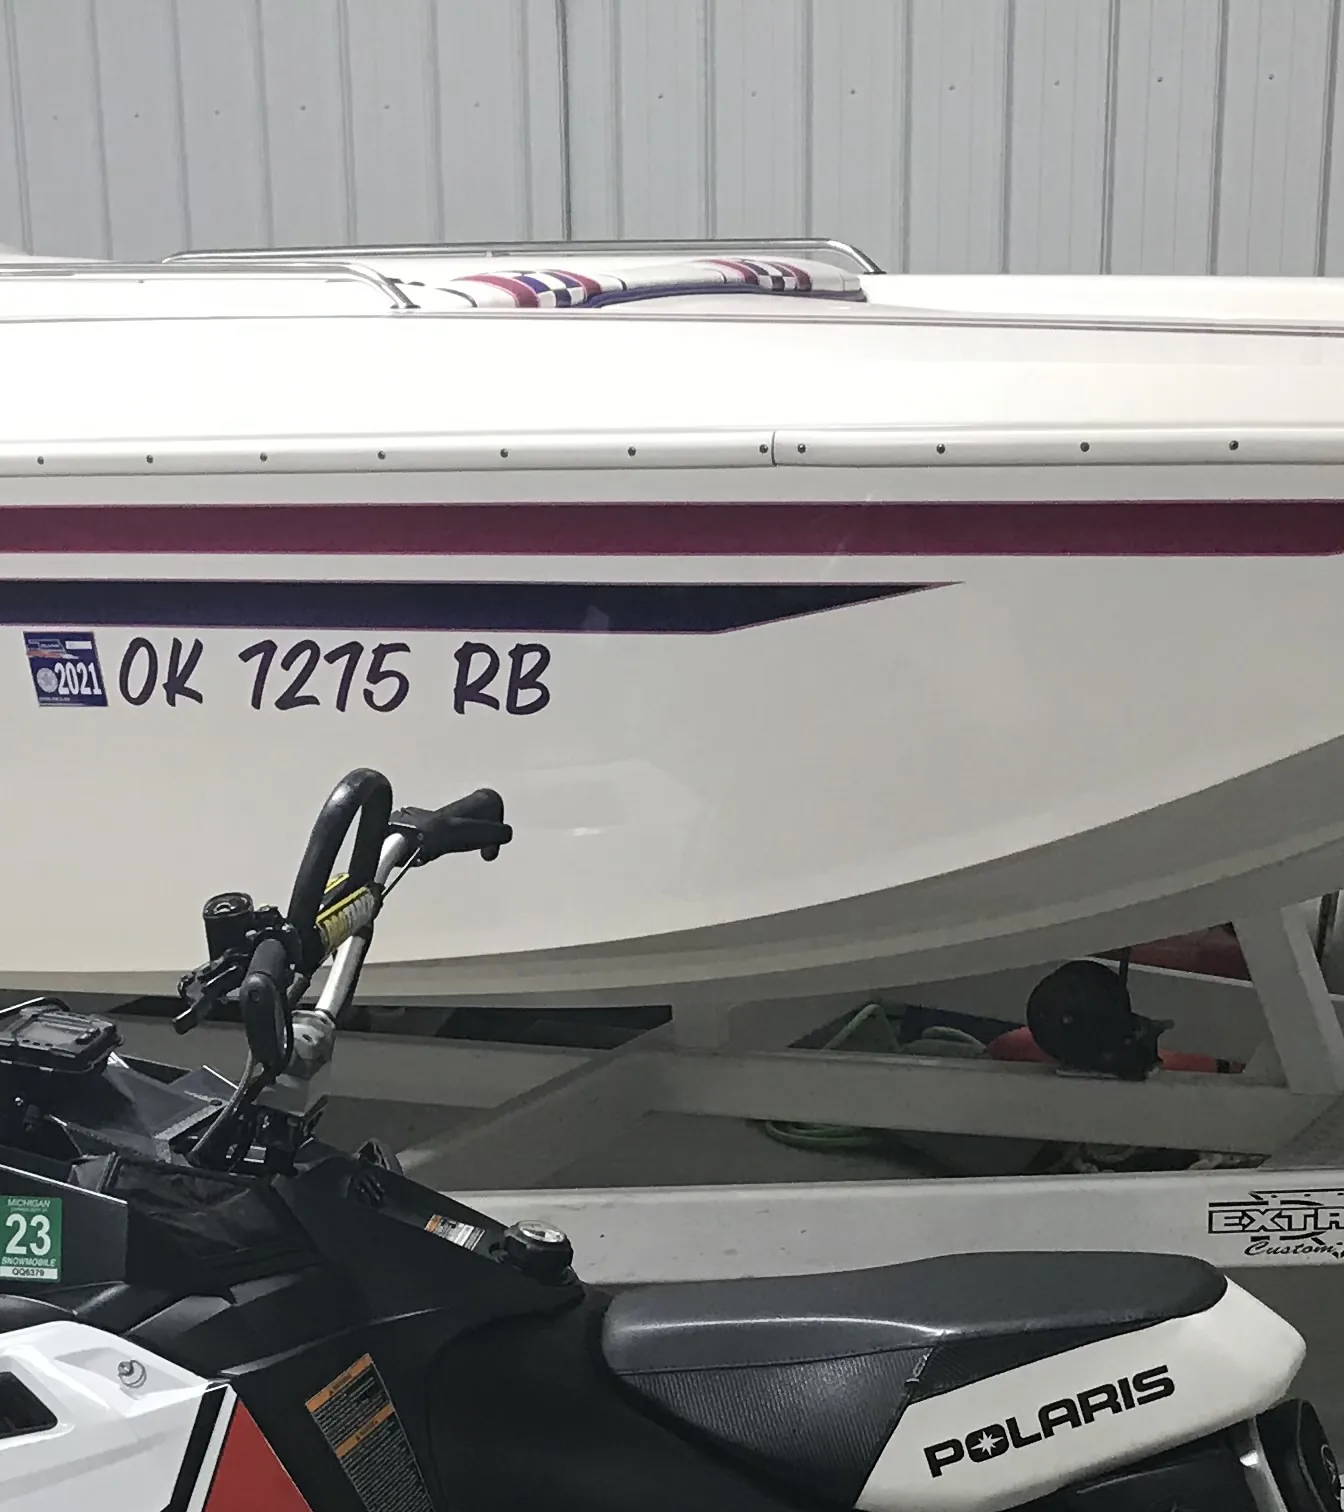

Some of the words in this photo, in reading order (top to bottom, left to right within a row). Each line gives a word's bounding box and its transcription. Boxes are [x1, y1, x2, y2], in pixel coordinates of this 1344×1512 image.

[54, 662, 102, 695] 2021
[119, 636, 204, 706] OK
[452, 642, 551, 715] RB
[8, 1199, 51, 1208] MICHIGAN
[5, 1213, 52, 1256] 23
[1244, 1240, 1338, 1256] Custom
[1, 1256, 56, 1268] SNOWMOBILE
[923, 1364, 1176, 1479] POLARIS
